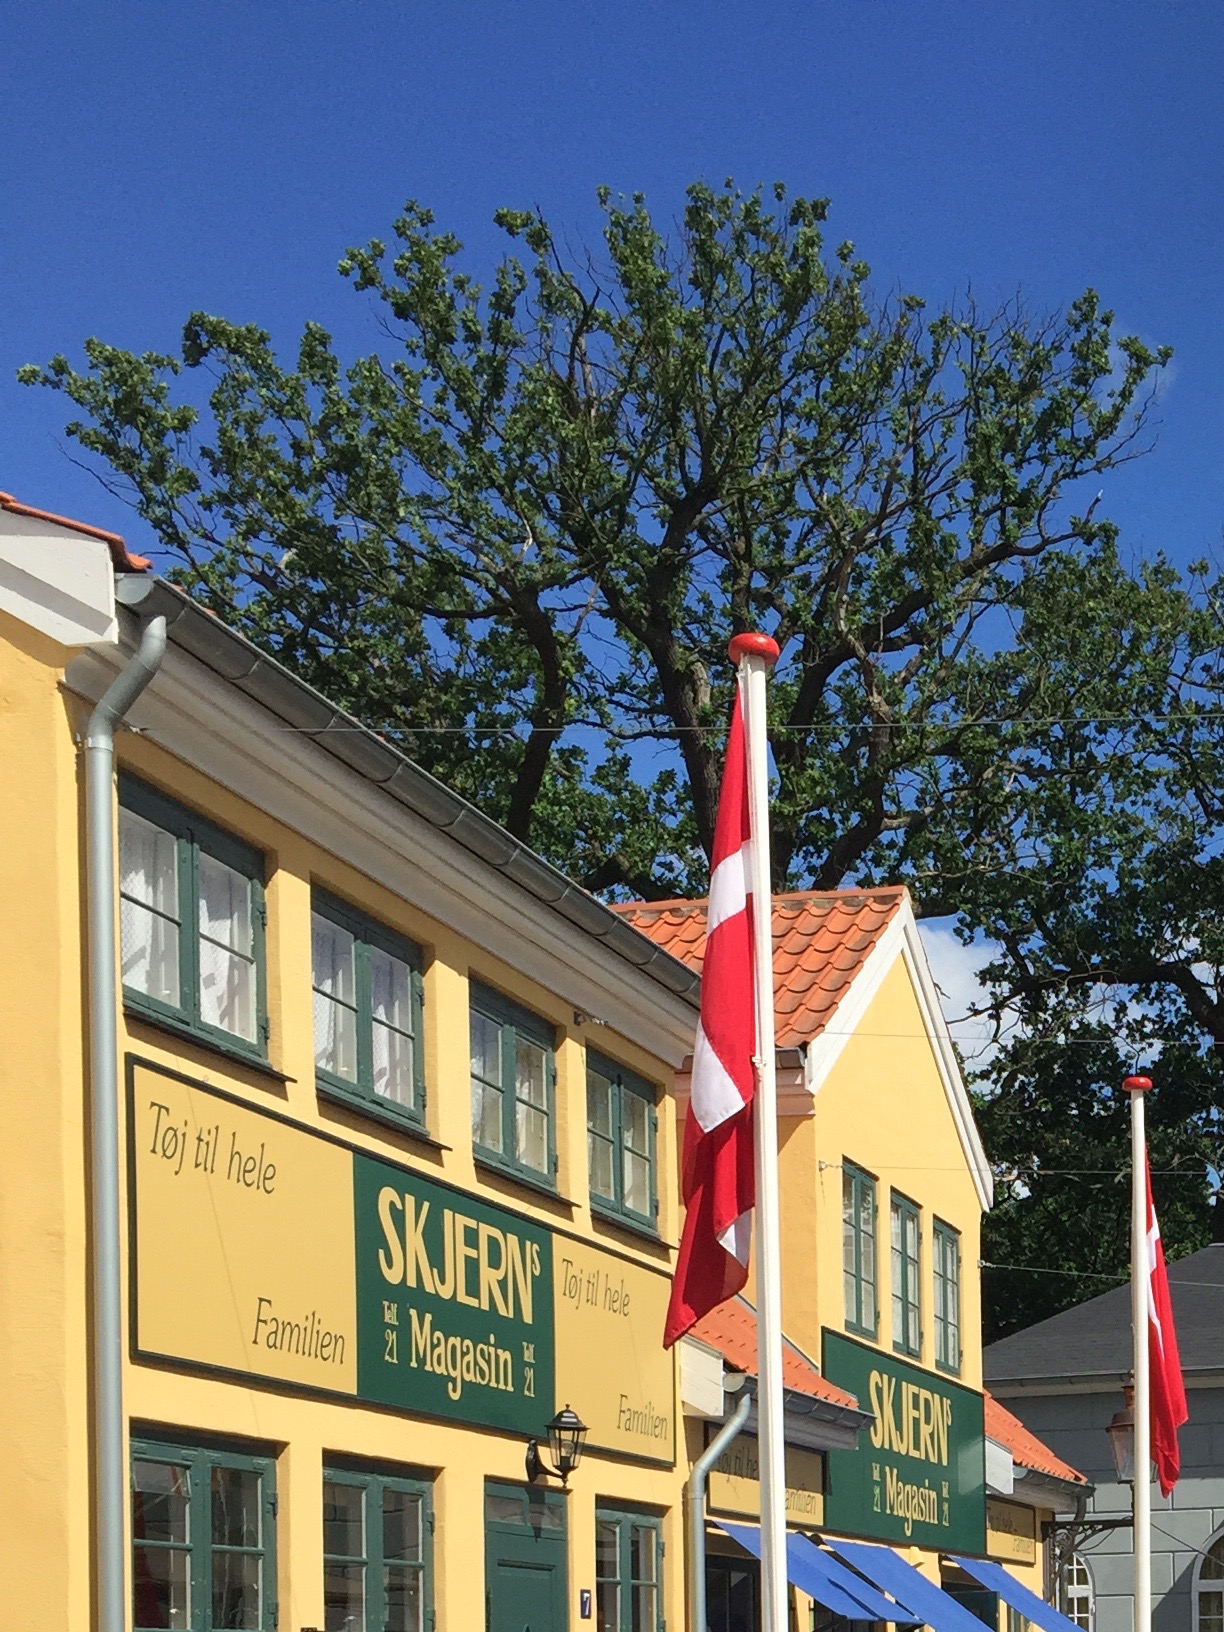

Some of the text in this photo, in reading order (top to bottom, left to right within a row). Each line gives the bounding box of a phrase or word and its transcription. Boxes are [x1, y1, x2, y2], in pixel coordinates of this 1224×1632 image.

[149, 1101, 277, 1194] Tøj til hele
[562, 1258, 630, 1317] Tøj til hele
[252, 1296, 346, 1365] Familien
[384, 1329, 399, 1364] 21
[409, 1307, 515, 1400] Magasin
[523, 1367, 536, 1398] 21
[617, 1393, 668, 1440] Familien
[884, 1465, 939, 1537] Magasin
[583, 1592, 591, 1616] 7
